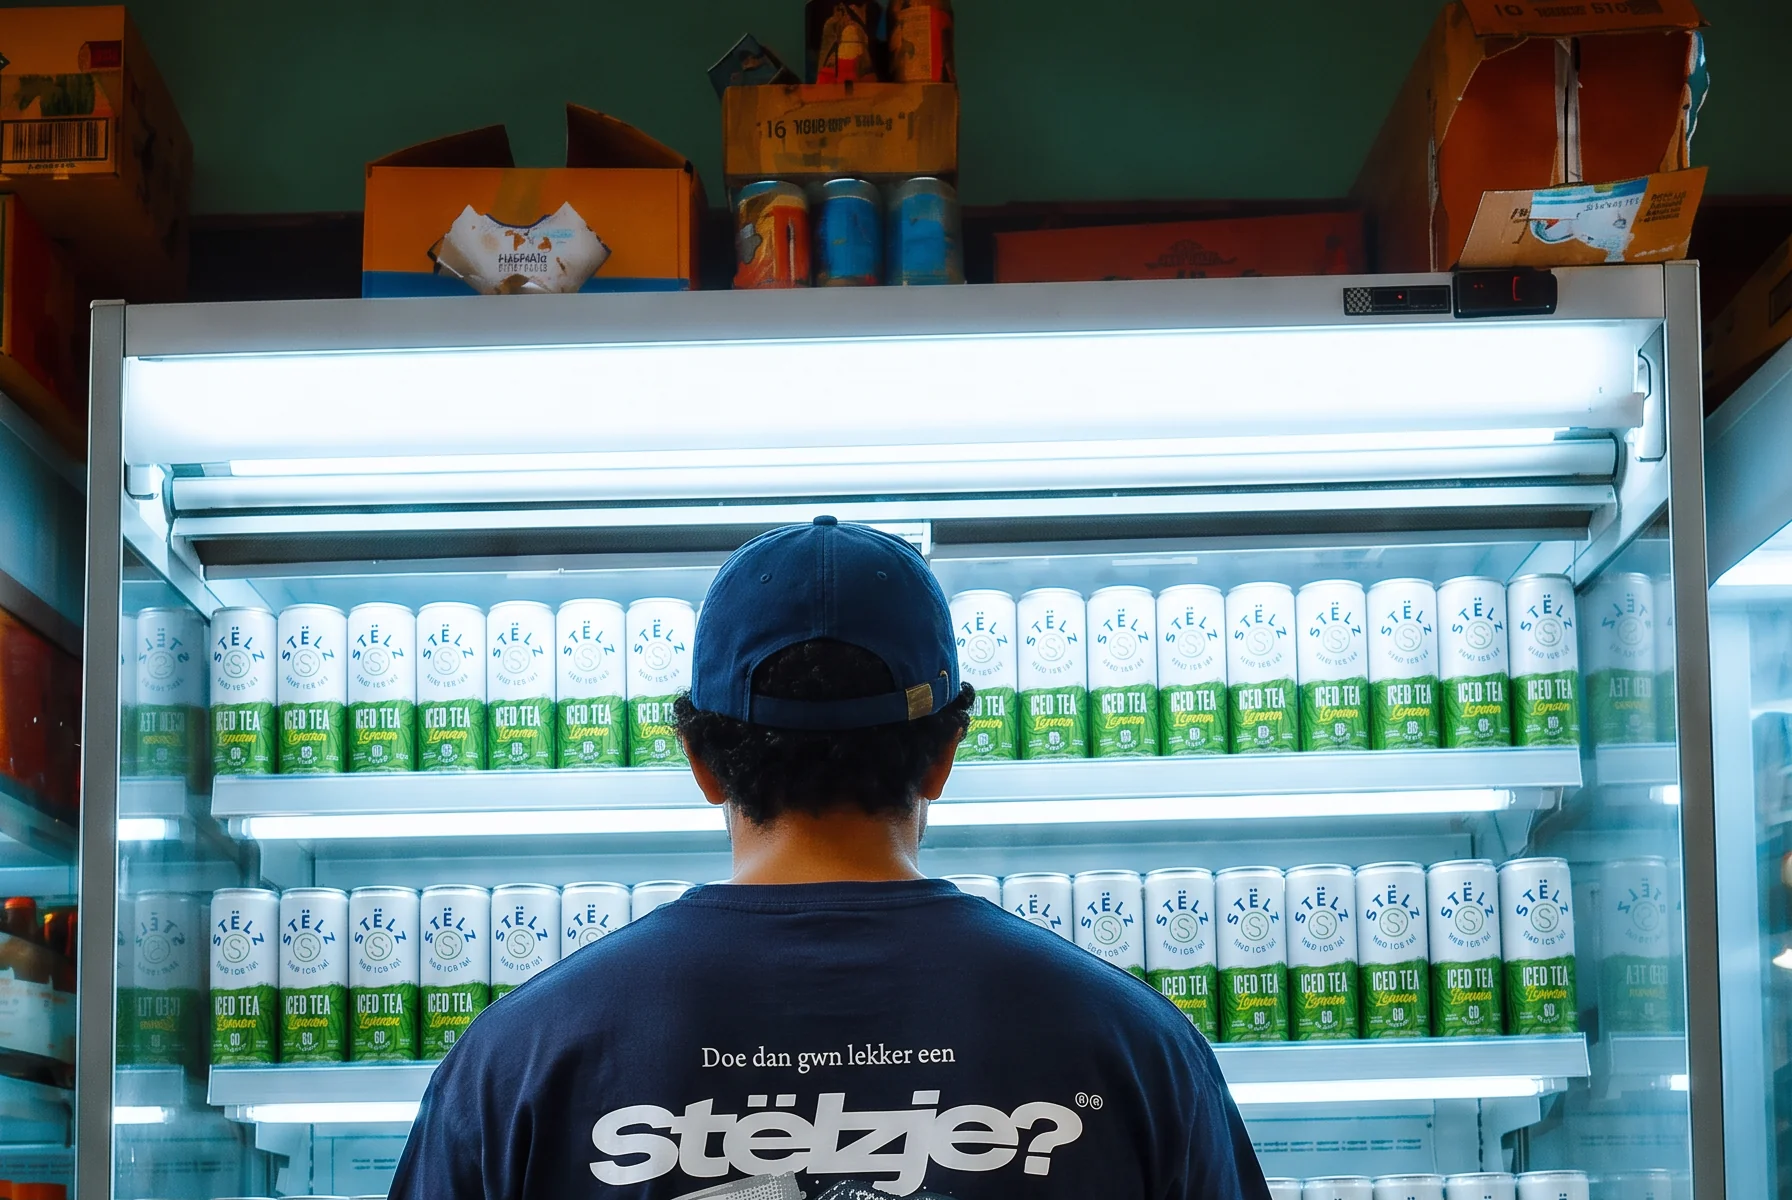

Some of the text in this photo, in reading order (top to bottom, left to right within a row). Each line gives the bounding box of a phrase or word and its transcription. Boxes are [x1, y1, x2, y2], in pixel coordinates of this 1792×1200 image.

[1027, 610, 1077, 646] STËLZ
[1097, 609, 1148, 644] STËLZ
[1166, 607, 1217, 643] STËLZ
[1234, 604, 1287, 640] STËLZ
[1310, 602, 1361, 638] STËLZ
[1381, 601, 1432, 636] STËLZ
[1452, 598, 1503, 634] STËLZ
[1520, 595, 1572, 632] STËLZ
[214, 627, 264, 662] STËLZ
[282, 626, 335, 661] STËLZ
[353, 625, 404, 660] STËLZ
[423, 624, 473, 659] STËLZ
[493, 623, 543, 658] STËLZ
[564, 621, 615, 656] STËLZ
[634, 619, 685, 654] STËLZ
[1196, 690, 1216, 710] TEA
[1264, 688, 1285, 708] TEA
[1342, 686, 1360, 705] TEA
[1485, 682, 1503, 701] TEA
[1015, 895, 1061, 929] TËLZ
[1081, 892, 1134, 929] STËLZ
[1156, 890, 1209, 926] STËLZ
[1228, 889, 1279, 925] STËLZ
[1295, 887, 1348, 923] STËLZ
[1366, 884, 1419, 921] STËLZ
[1441, 882, 1494, 918] STËLZ
[1516, 879, 1569, 916] STËLZ
[213, 910, 264, 946] STËLZ
[283, 909, 336, 945] STËLZ
[355, 908, 406, 944] STËLZ
[424, 908, 476, 943] STËLZ
[496, 906, 548, 942] STËLZ
[567, 904, 618, 939] STËL
[1261, 974, 1278, 992] TEA
[1328, 972, 1347, 992] TEA
[1400, 970, 1419, 990] TEA
[1475, 968, 1493, 988] TEA
[238, 996, 259, 1015] TEA
[382, 994, 403, 1014] TEA
[452, 993, 472, 1012] TEA
[702, 1043, 956, 1074] Doe dan gwn lekker een
